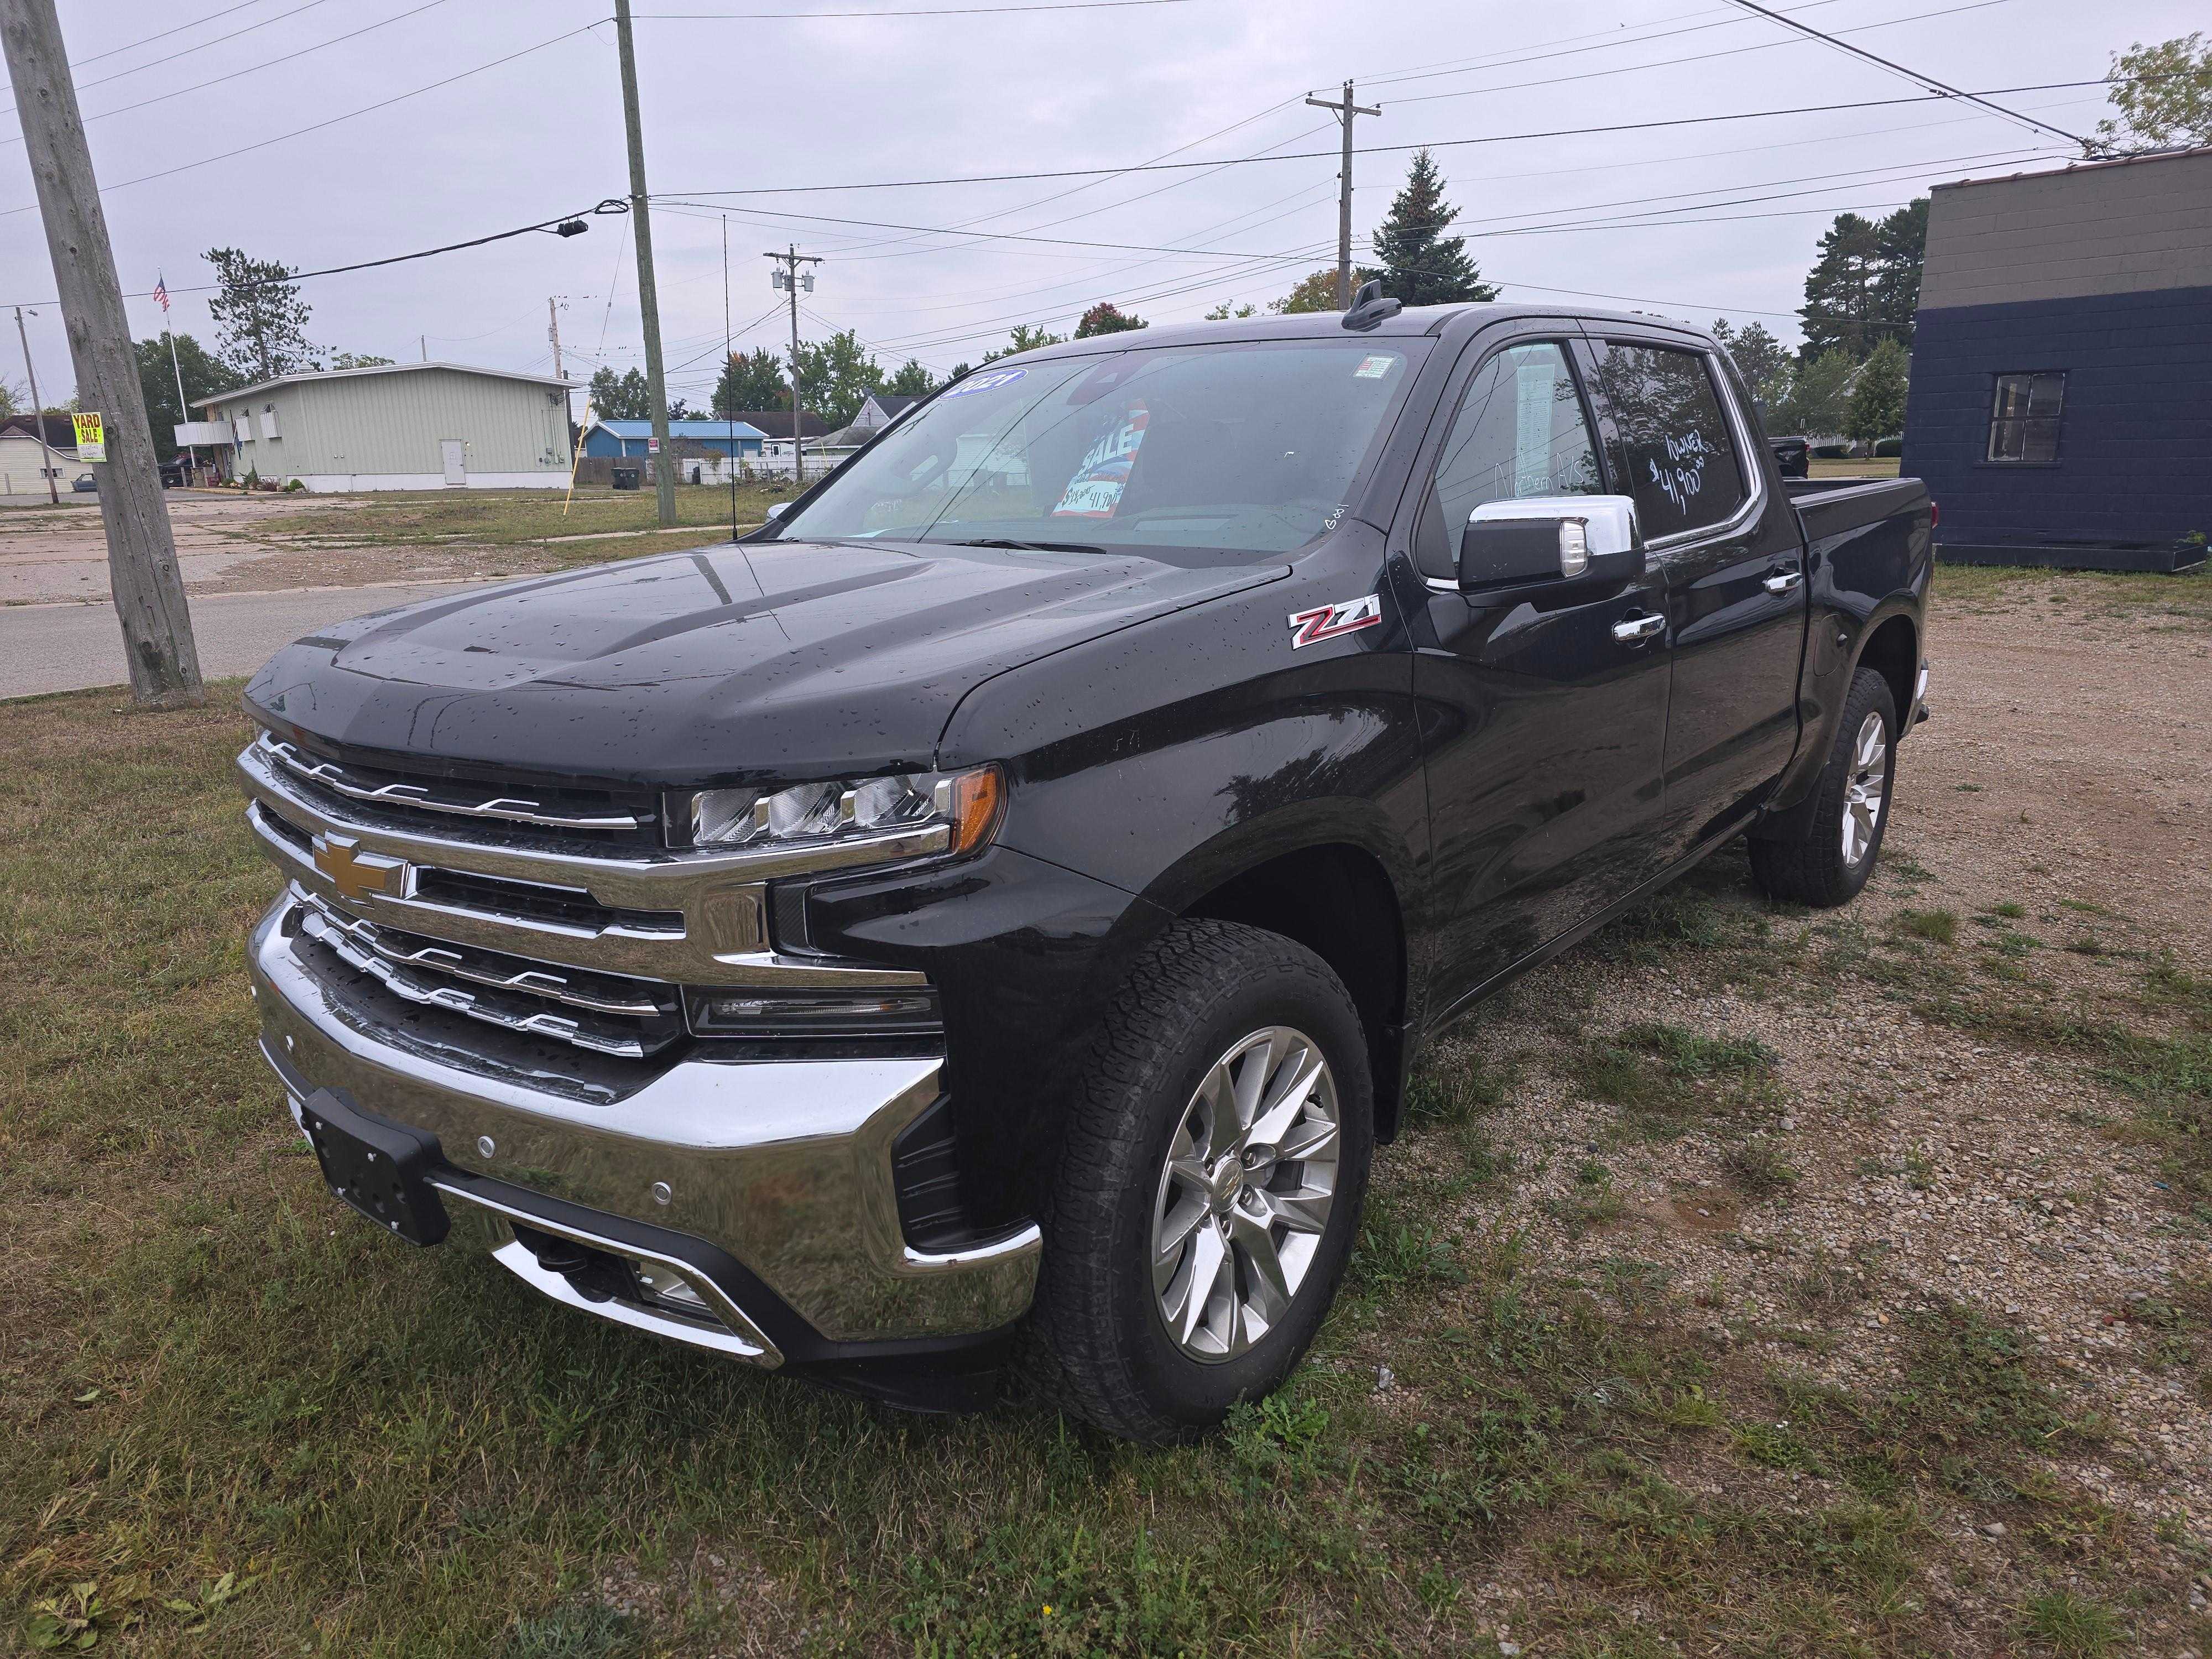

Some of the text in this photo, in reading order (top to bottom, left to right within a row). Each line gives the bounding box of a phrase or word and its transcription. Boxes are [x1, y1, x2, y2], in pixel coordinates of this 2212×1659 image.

[73, 414, 100, 429] YARD
[81, 429, 98, 443] SALE
[1077, 424, 1134, 476] SALE
[1287, 593, 1382, 651] Z71
